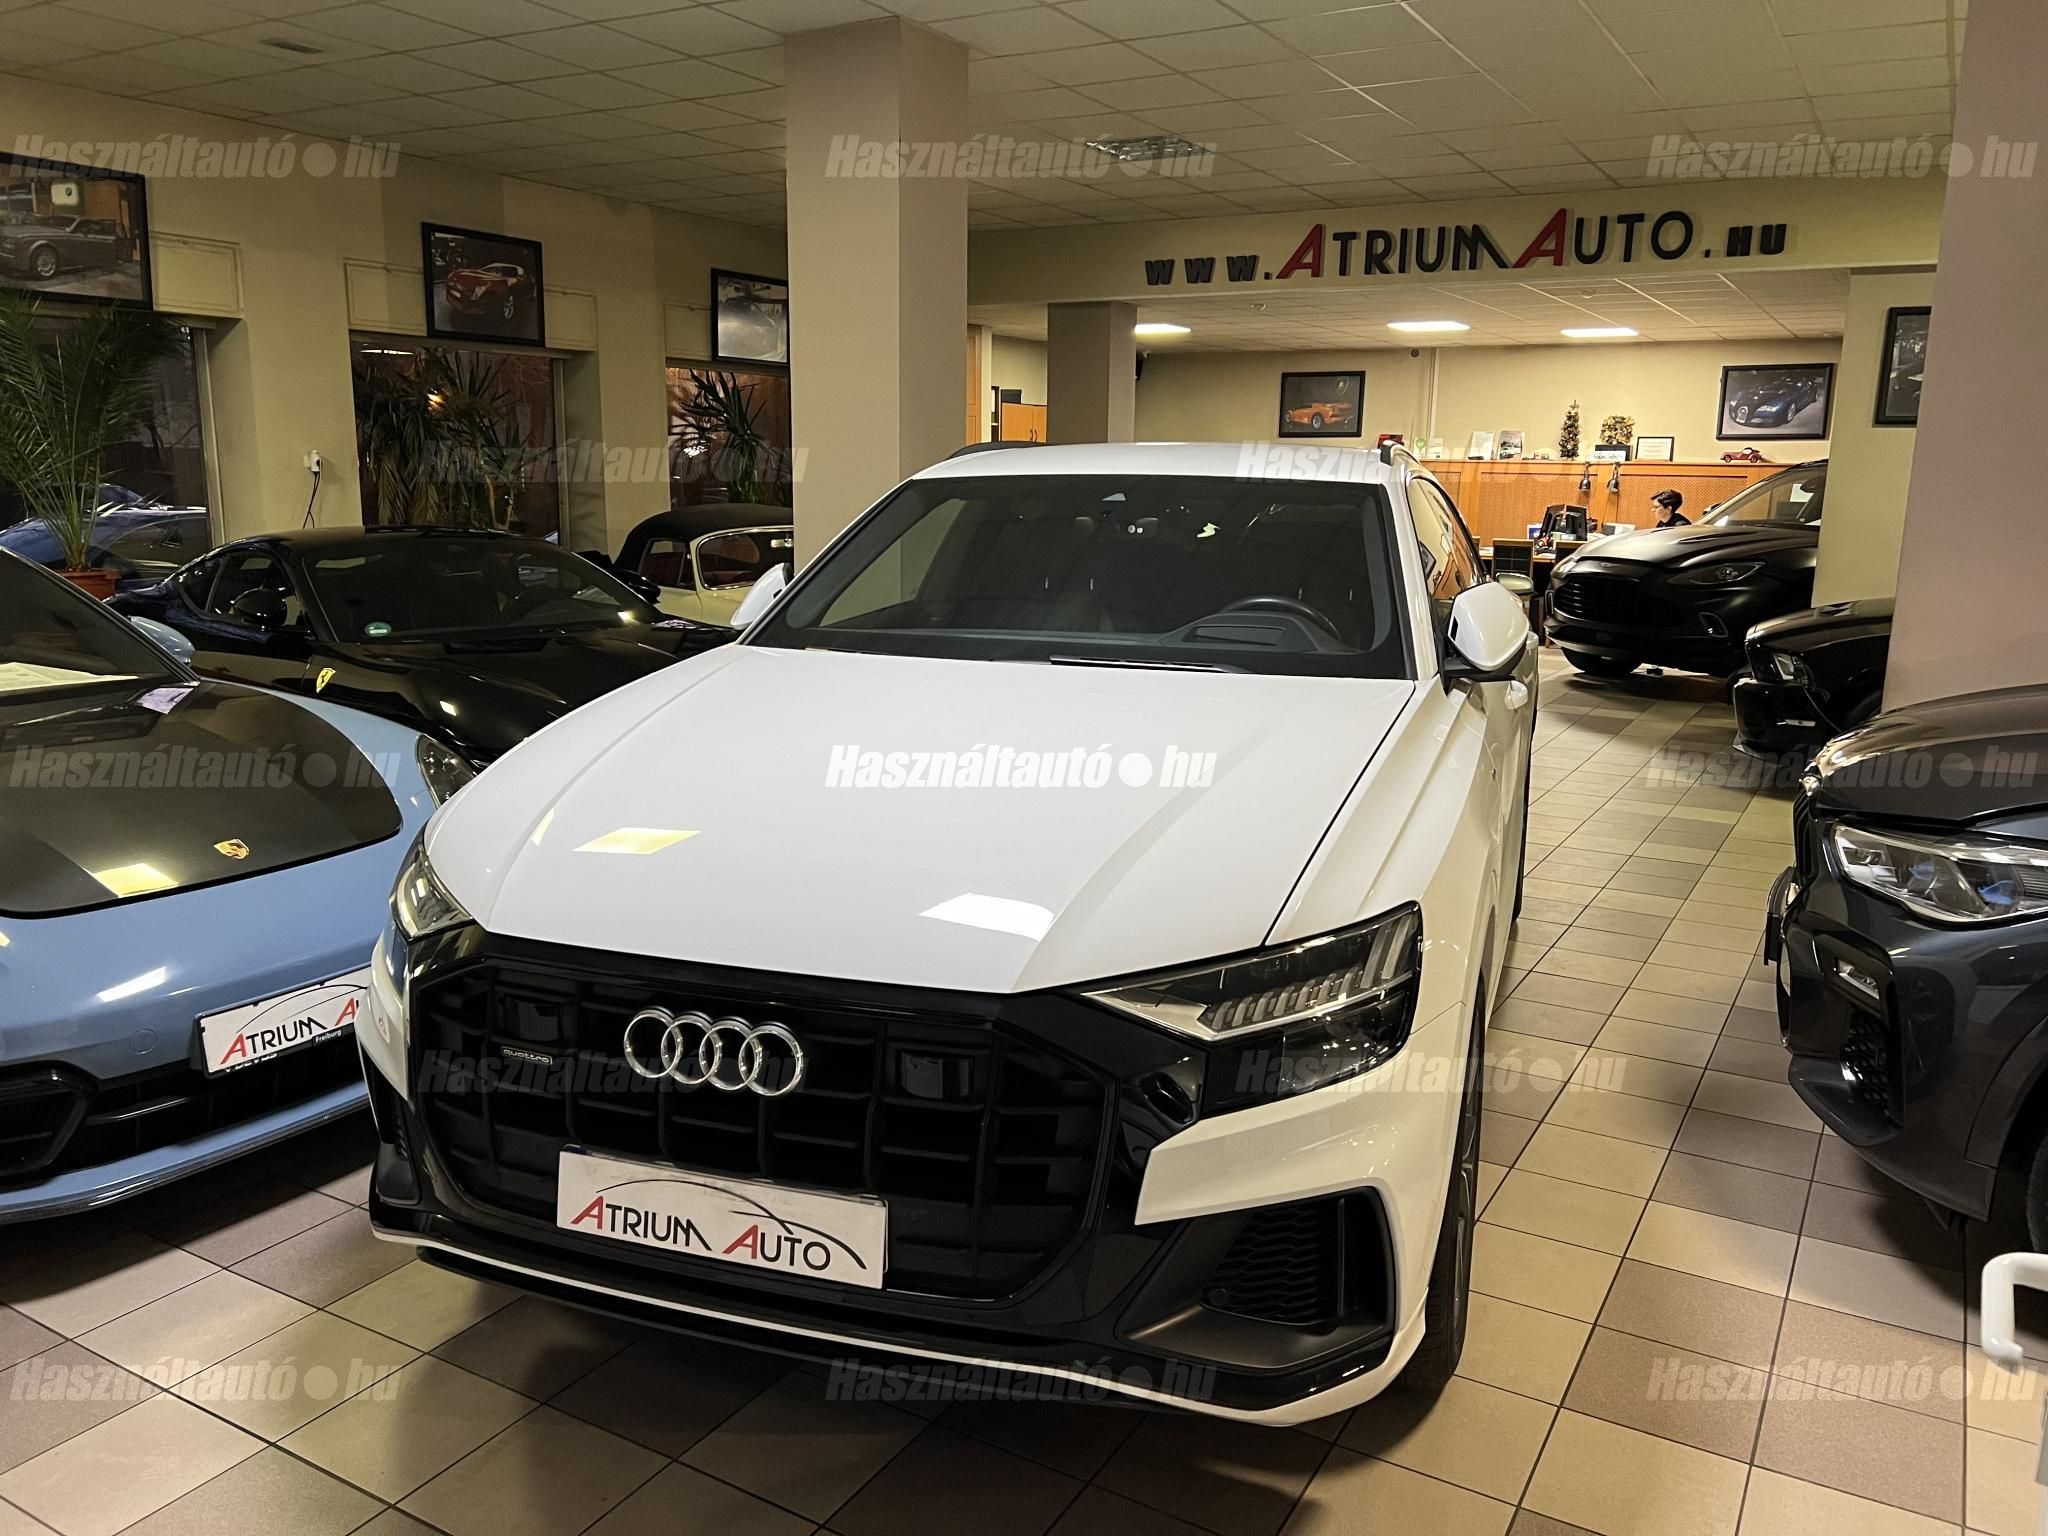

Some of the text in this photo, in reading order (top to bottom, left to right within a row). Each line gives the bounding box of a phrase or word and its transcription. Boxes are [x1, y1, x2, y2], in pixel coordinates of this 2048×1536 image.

[220, 1016, 328, 1065] ATRIUM
[315, 1029, 342, 1043] Freiburg
[503, 1049, 550, 1063] quattro
[570, 1195, 831, 1271] ATRIUM AUTO
